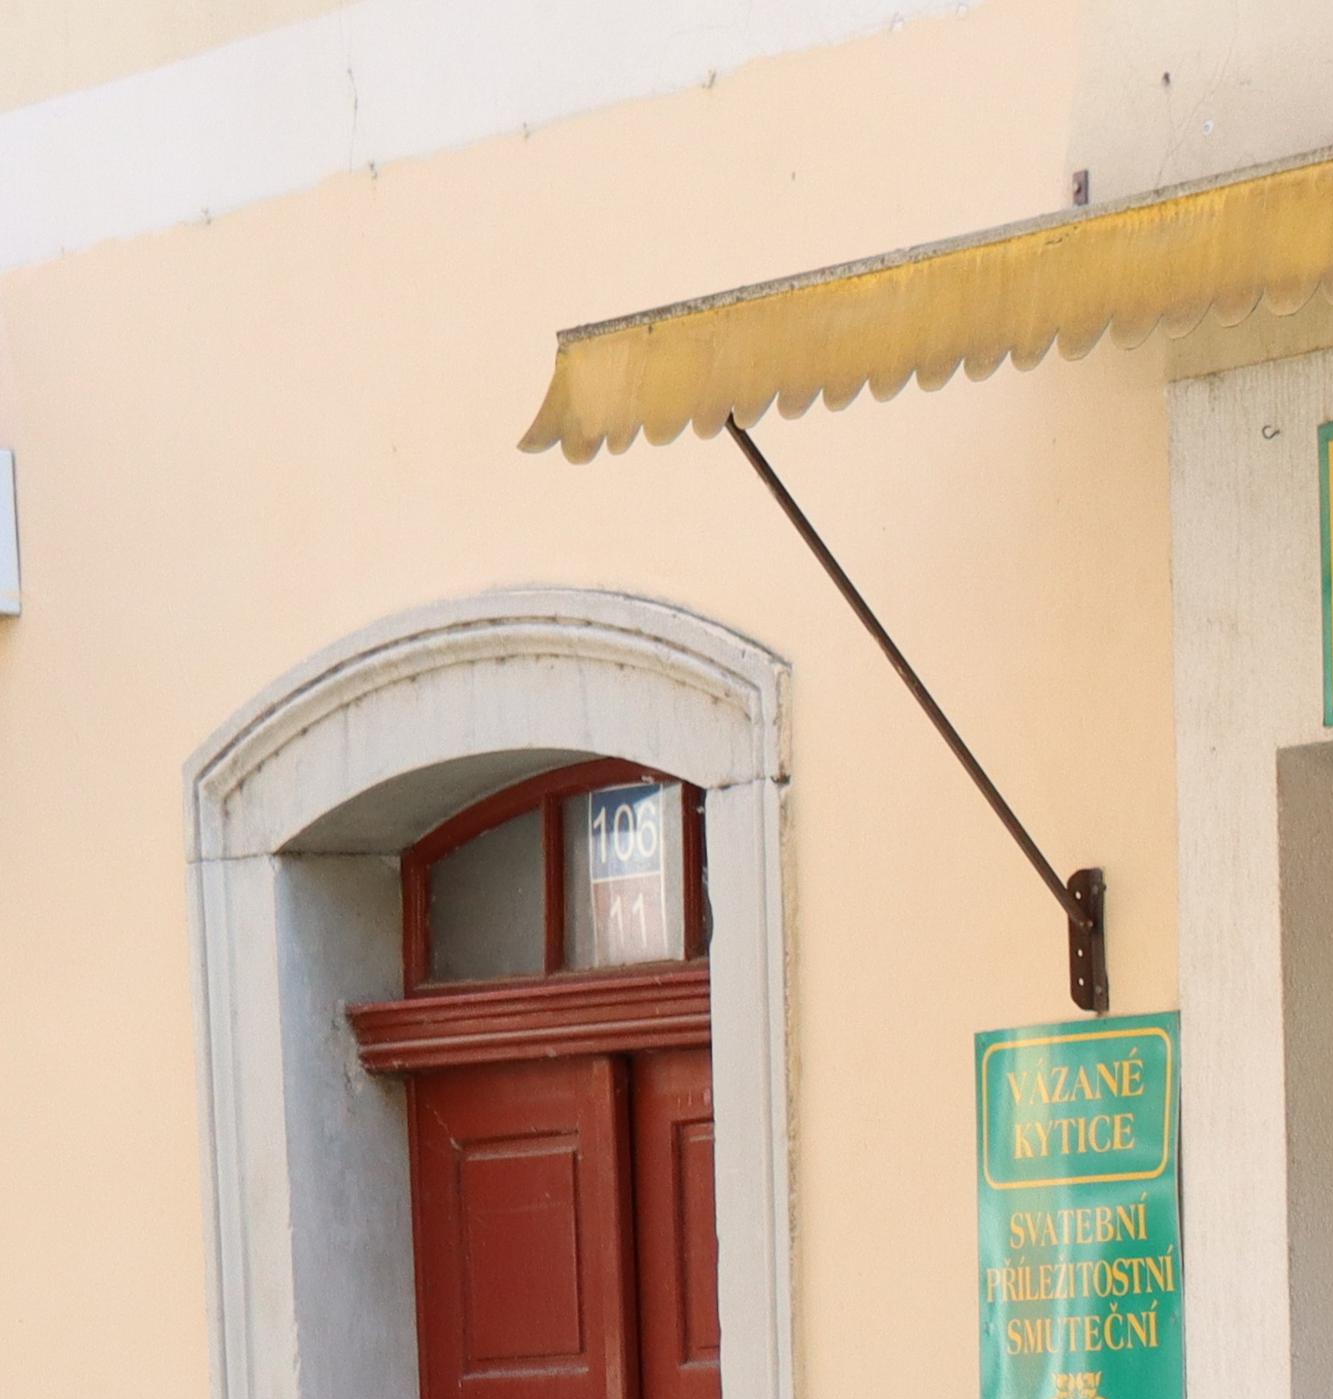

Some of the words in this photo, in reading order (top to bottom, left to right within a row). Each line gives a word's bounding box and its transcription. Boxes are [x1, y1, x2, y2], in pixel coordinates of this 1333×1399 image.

[593, 802, 658, 864] 106
[609, 892, 648, 948] 11
[1007, 1047, 1144, 1106] VÁZANÉ
[1014, 1113, 1136, 1160] KYTICE
[1010, 1192, 1148, 1250] SVATEBNÍ
[986, 1245, 1176, 1303] PŘÍLEŽITOSTNÍ
[1007, 1302, 1159, 1355] SMUTEČNÍ
